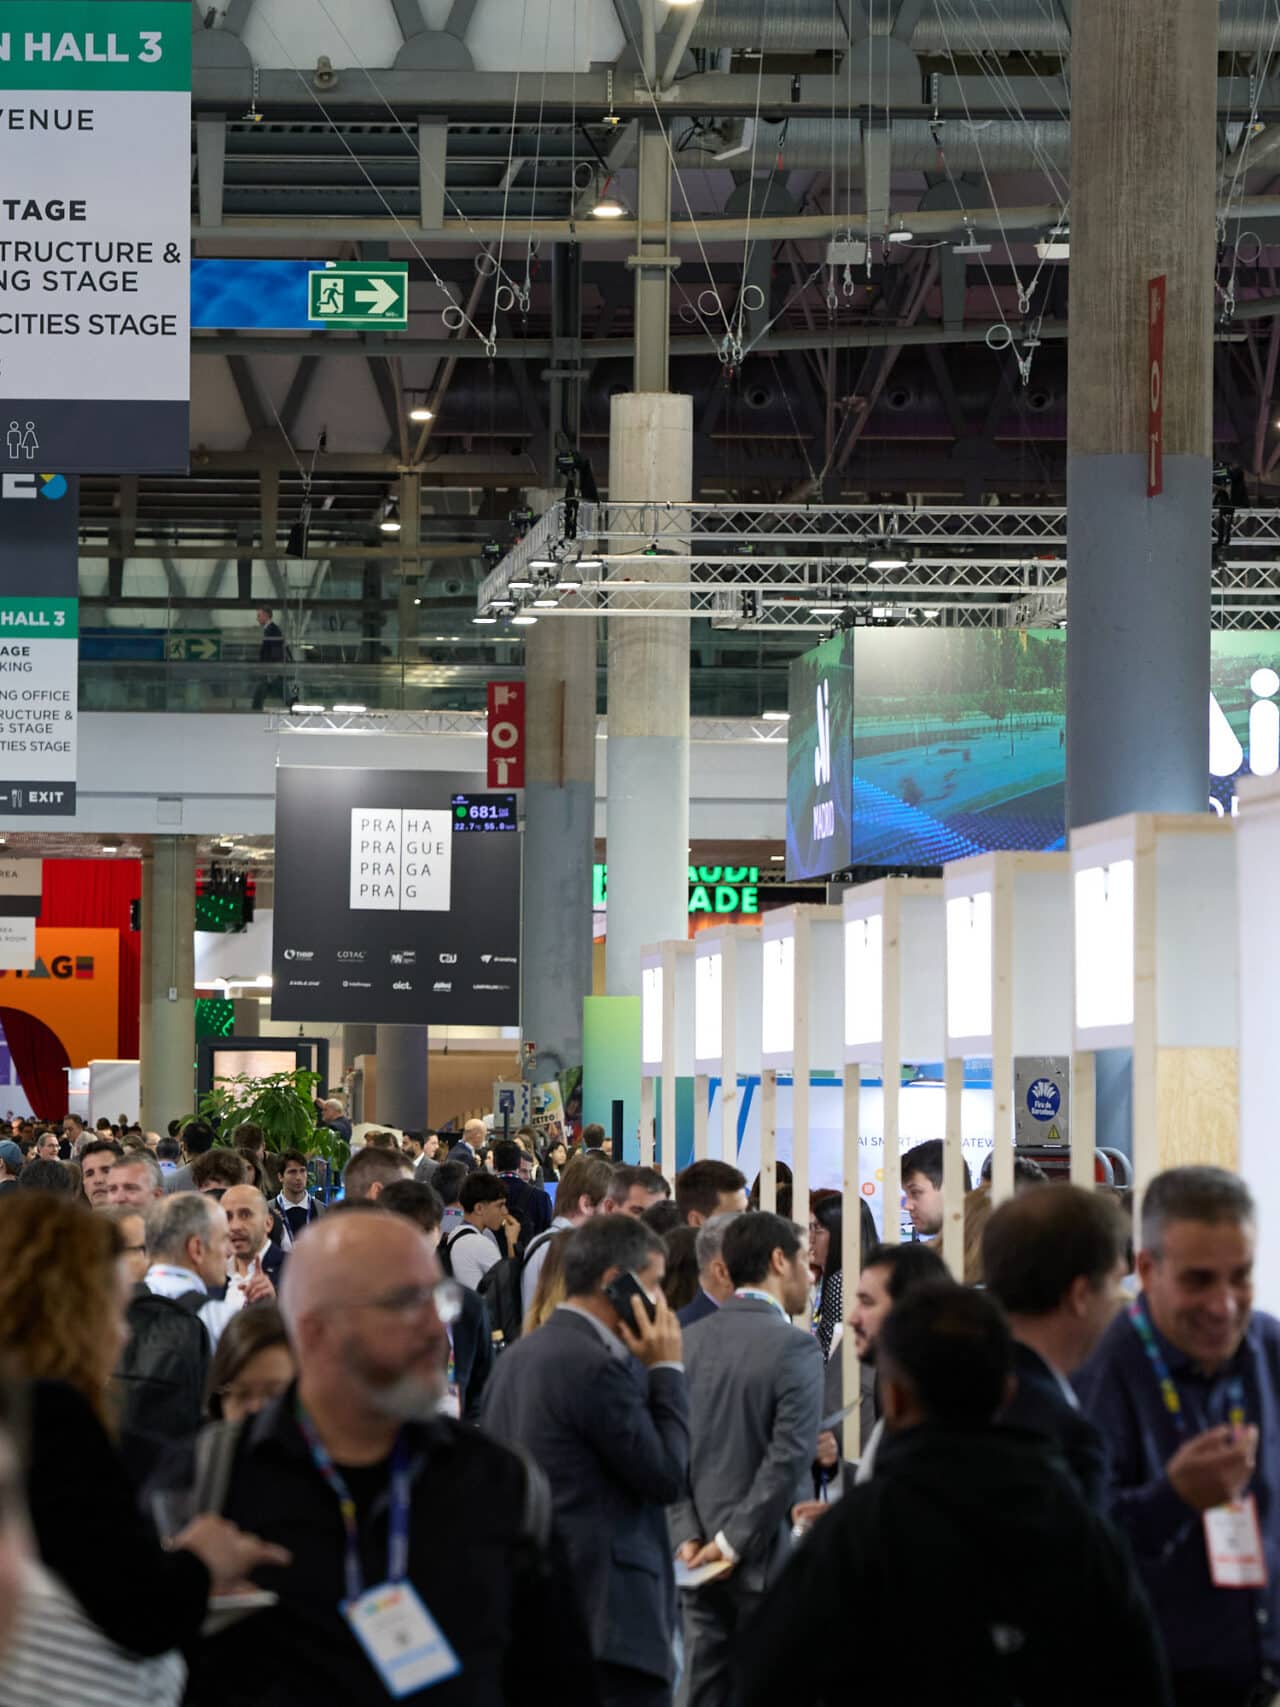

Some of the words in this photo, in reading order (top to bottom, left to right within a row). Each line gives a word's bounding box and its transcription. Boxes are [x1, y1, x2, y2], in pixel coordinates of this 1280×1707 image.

[25, 31, 130, 63] HALL
[138, 31, 163, 63] 3
[162, 242, 182, 264] &
[42, 269, 139, 293] STAGE
[88, 313, 178, 337] STAGE
[1, 610, 50, 626] HALL
[53, 611, 66, 626] 3
[21, 690, 70, 702] OFFICE
[64, 710, 73, 721] &
[9, 723, 54, 734] STAGE
[30, 740, 72, 753] STAGE
[28, 791, 65, 803] EXIT
[470, 806, 498, 819] 681
[360, 818, 433, 833] PRAHA
[360, 840, 445, 856] PRAGUE
[359, 862, 432, 877] PRAGA
[359, 883, 418, 898] PRAG
[688, 886, 759, 913] ADE
